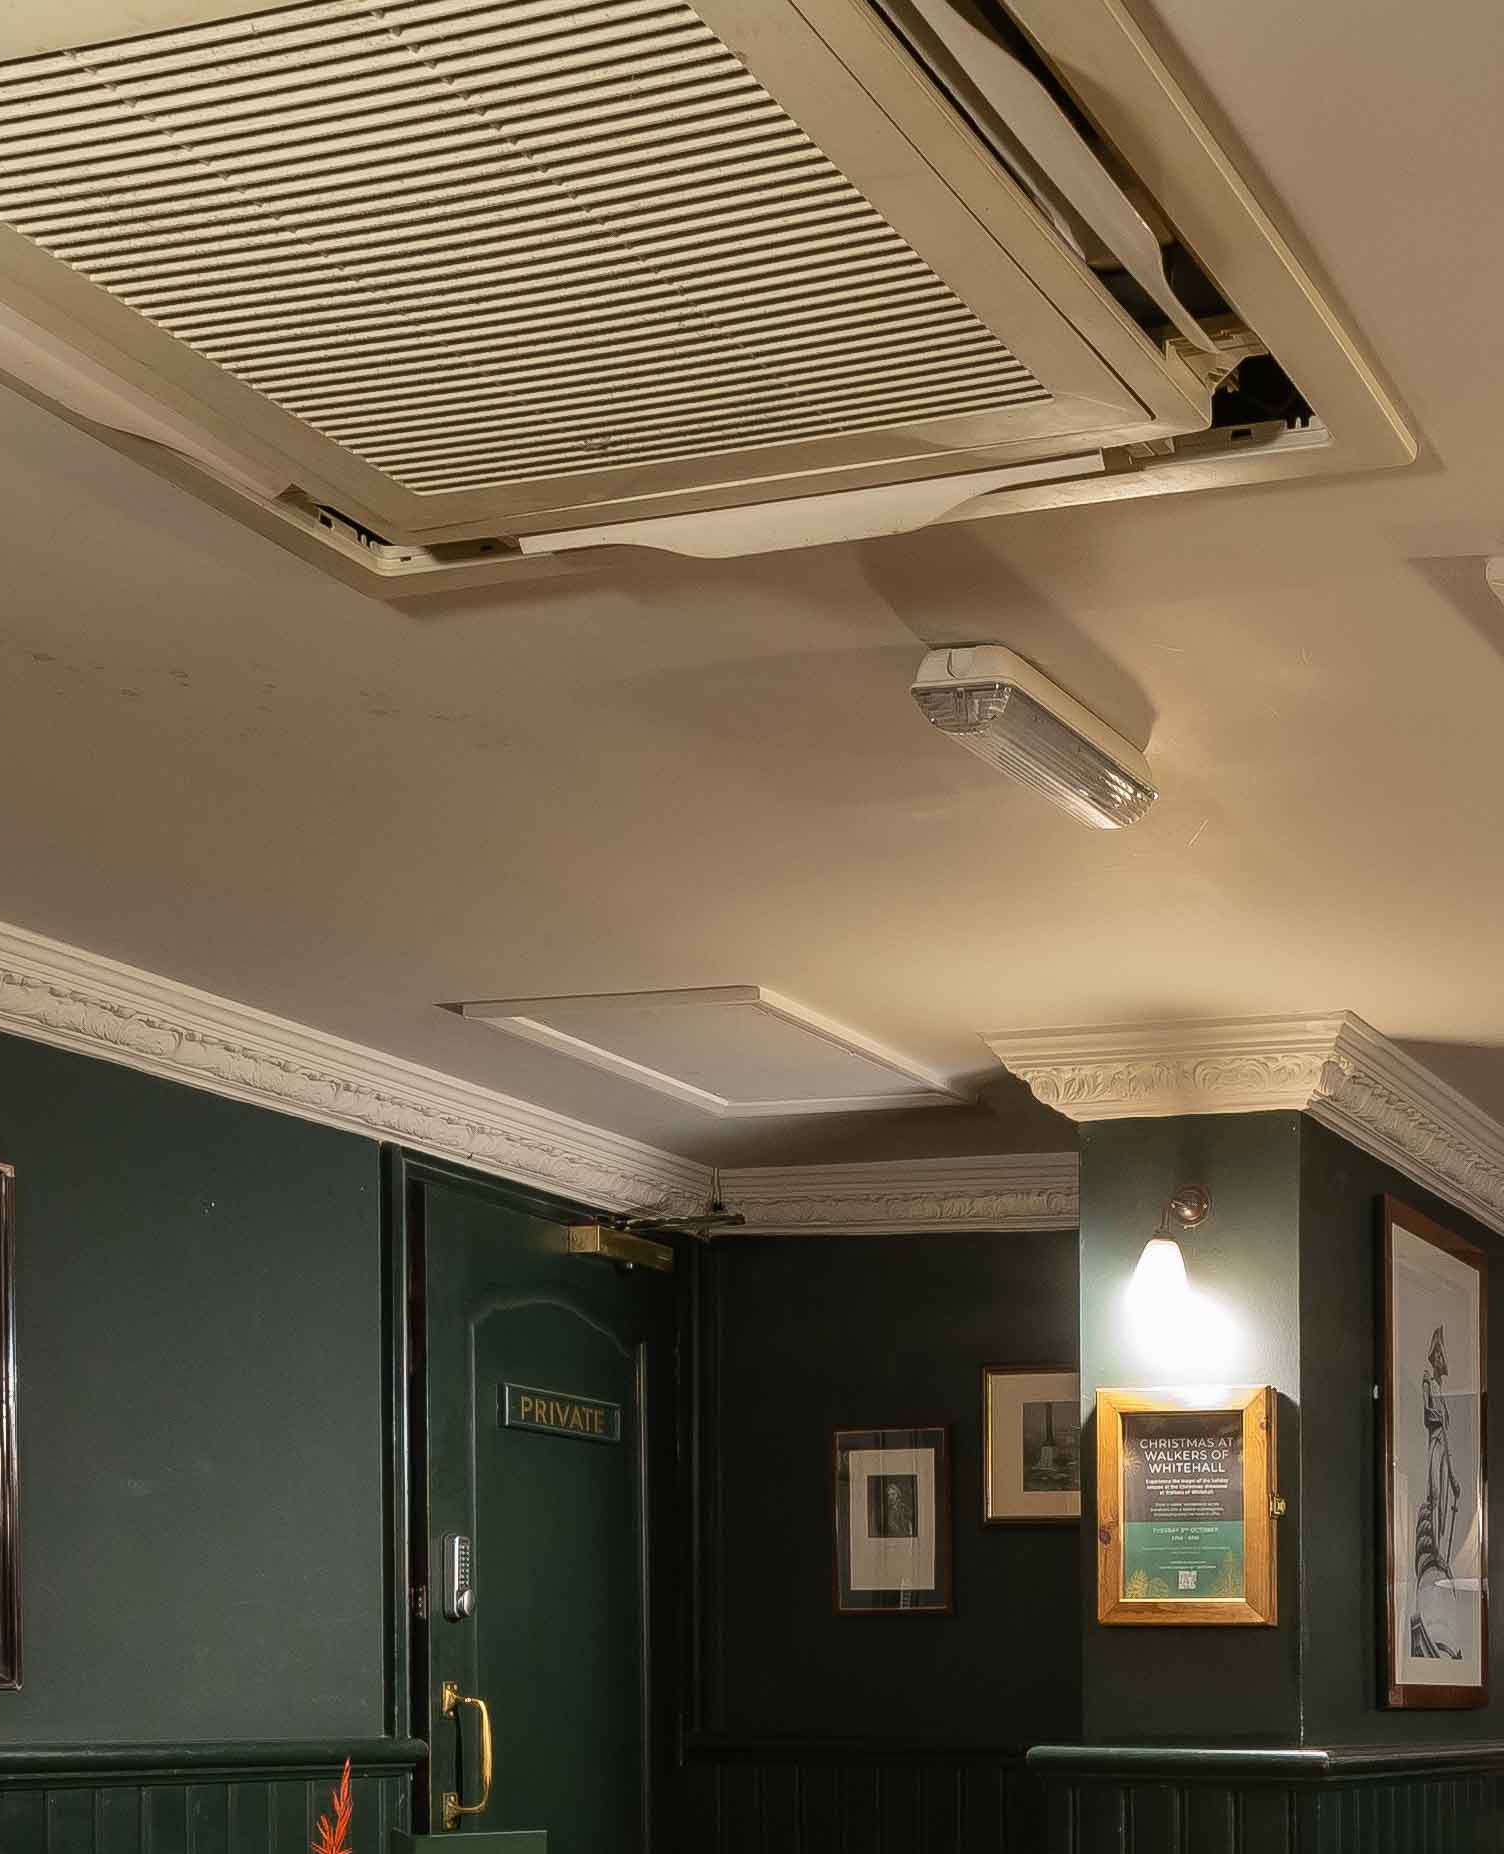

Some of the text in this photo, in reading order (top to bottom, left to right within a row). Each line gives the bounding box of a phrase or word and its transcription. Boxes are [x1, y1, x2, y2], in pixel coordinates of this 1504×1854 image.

[520, 1395, 604, 1433] PRIVATE
[1139, 1437, 1233, 1449] CHRISTMAS AT
[1144, 1449, 1229, 1461] WALKERS OF
[1148, 1462, 1226, 1473] WHITEHALL
